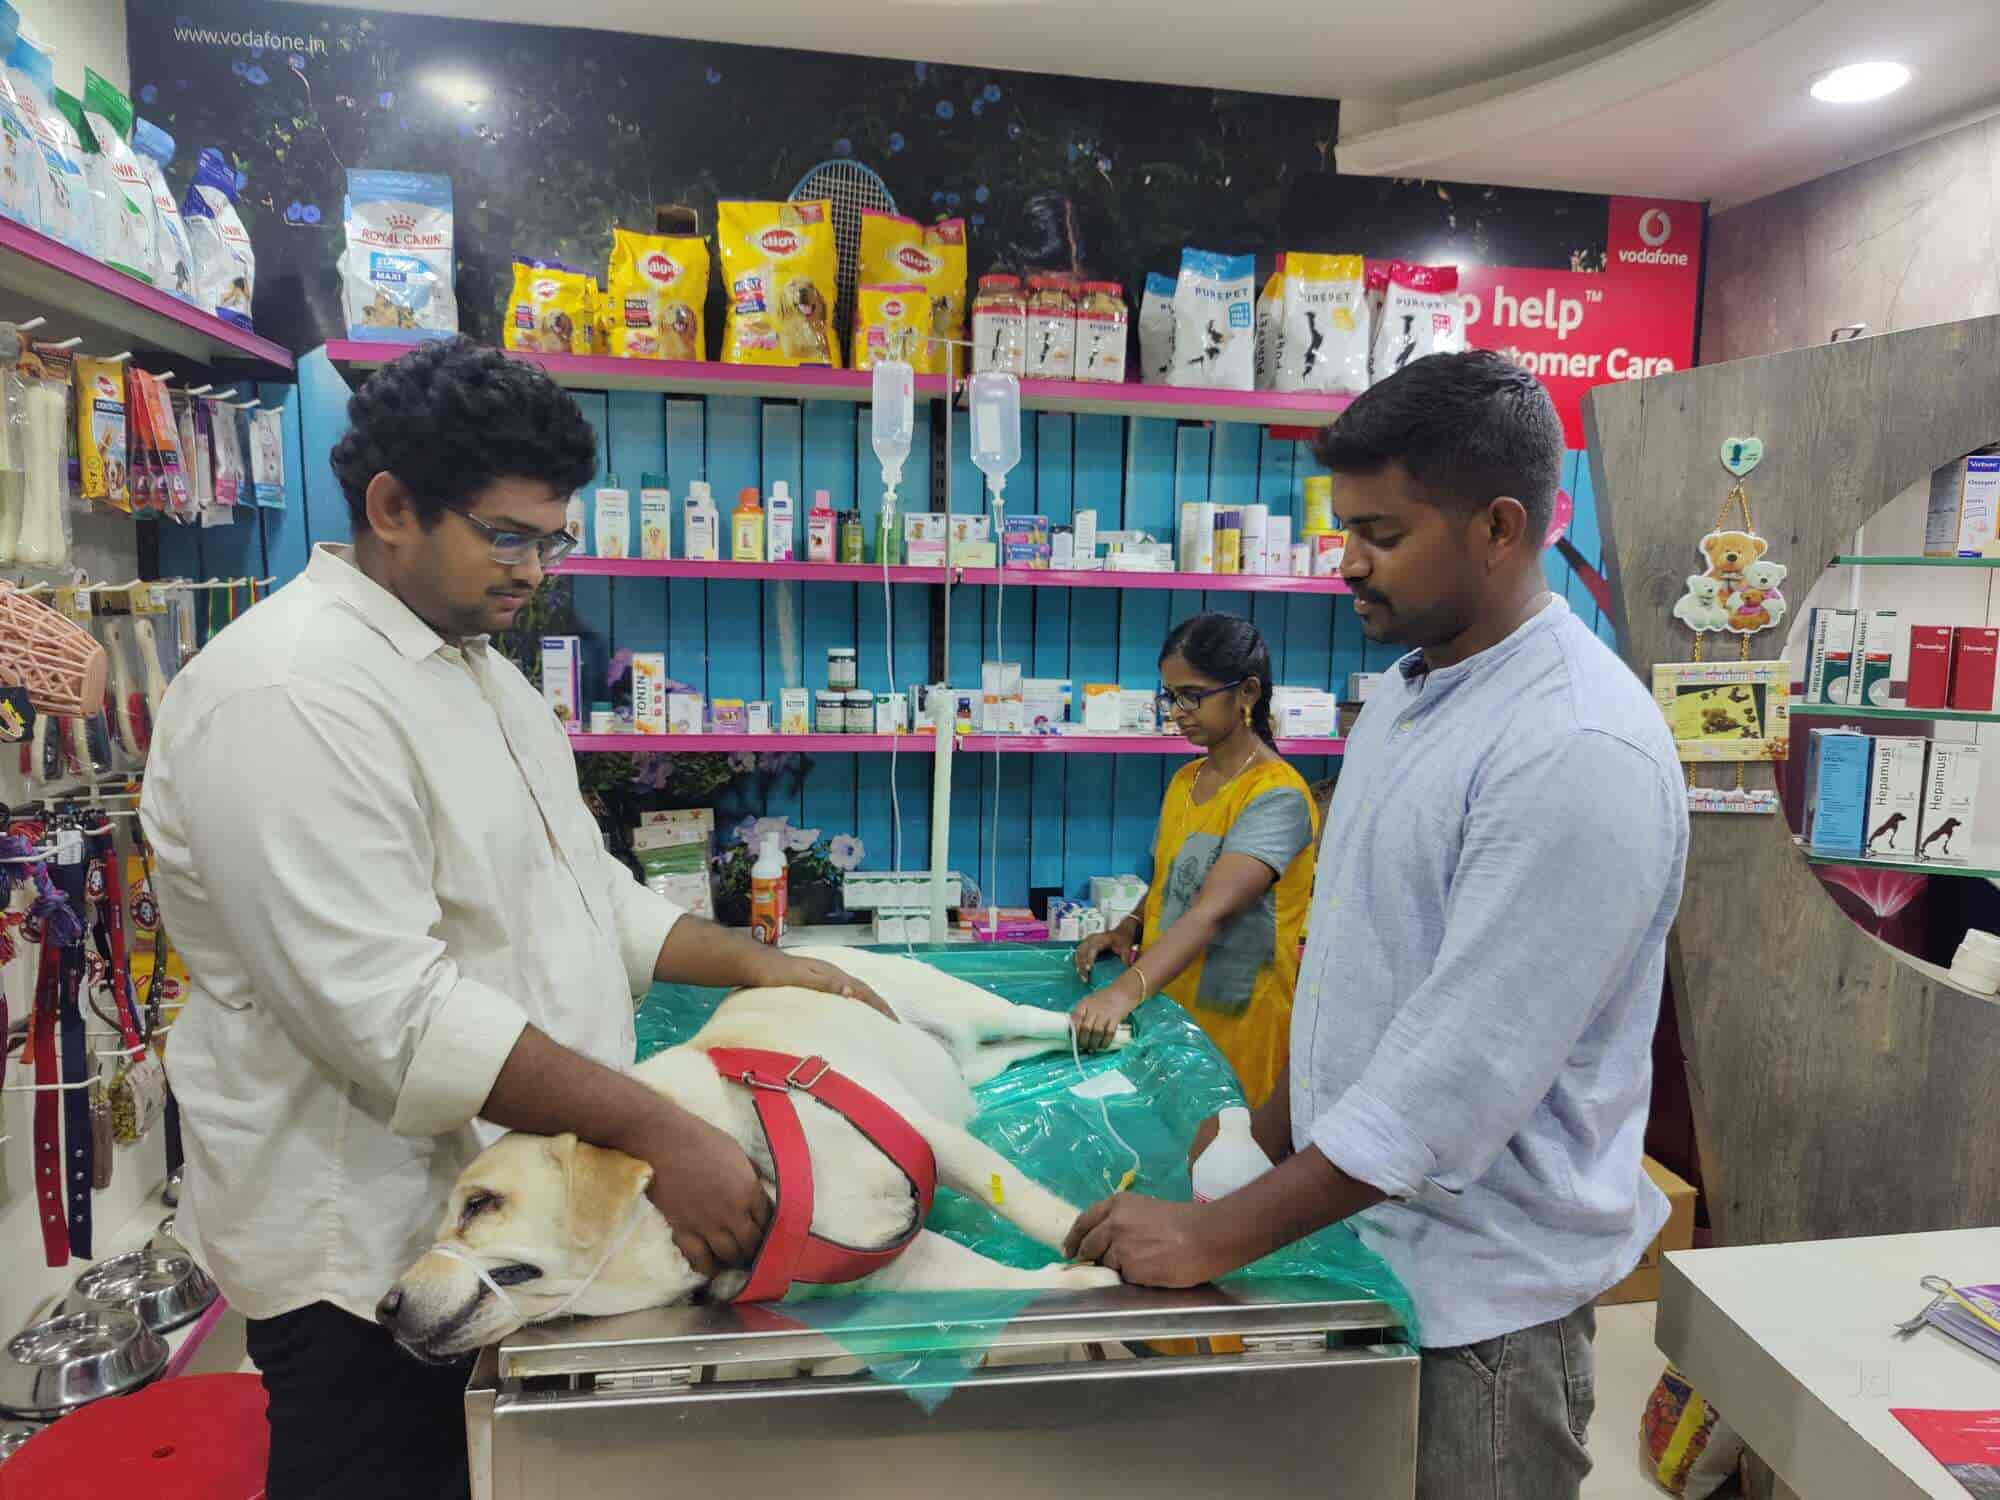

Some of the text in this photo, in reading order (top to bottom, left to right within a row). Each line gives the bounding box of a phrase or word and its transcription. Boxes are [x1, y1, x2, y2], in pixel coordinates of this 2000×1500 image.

[362, 228, 442, 246] ROYAL CANIN
[1619, 249, 1689, 266] vodafone
[1607, 348, 1674, 380] Care
[1875, 747, 1891, 806] Hepamust
[1930, 752, 1948, 810] Hepamust
